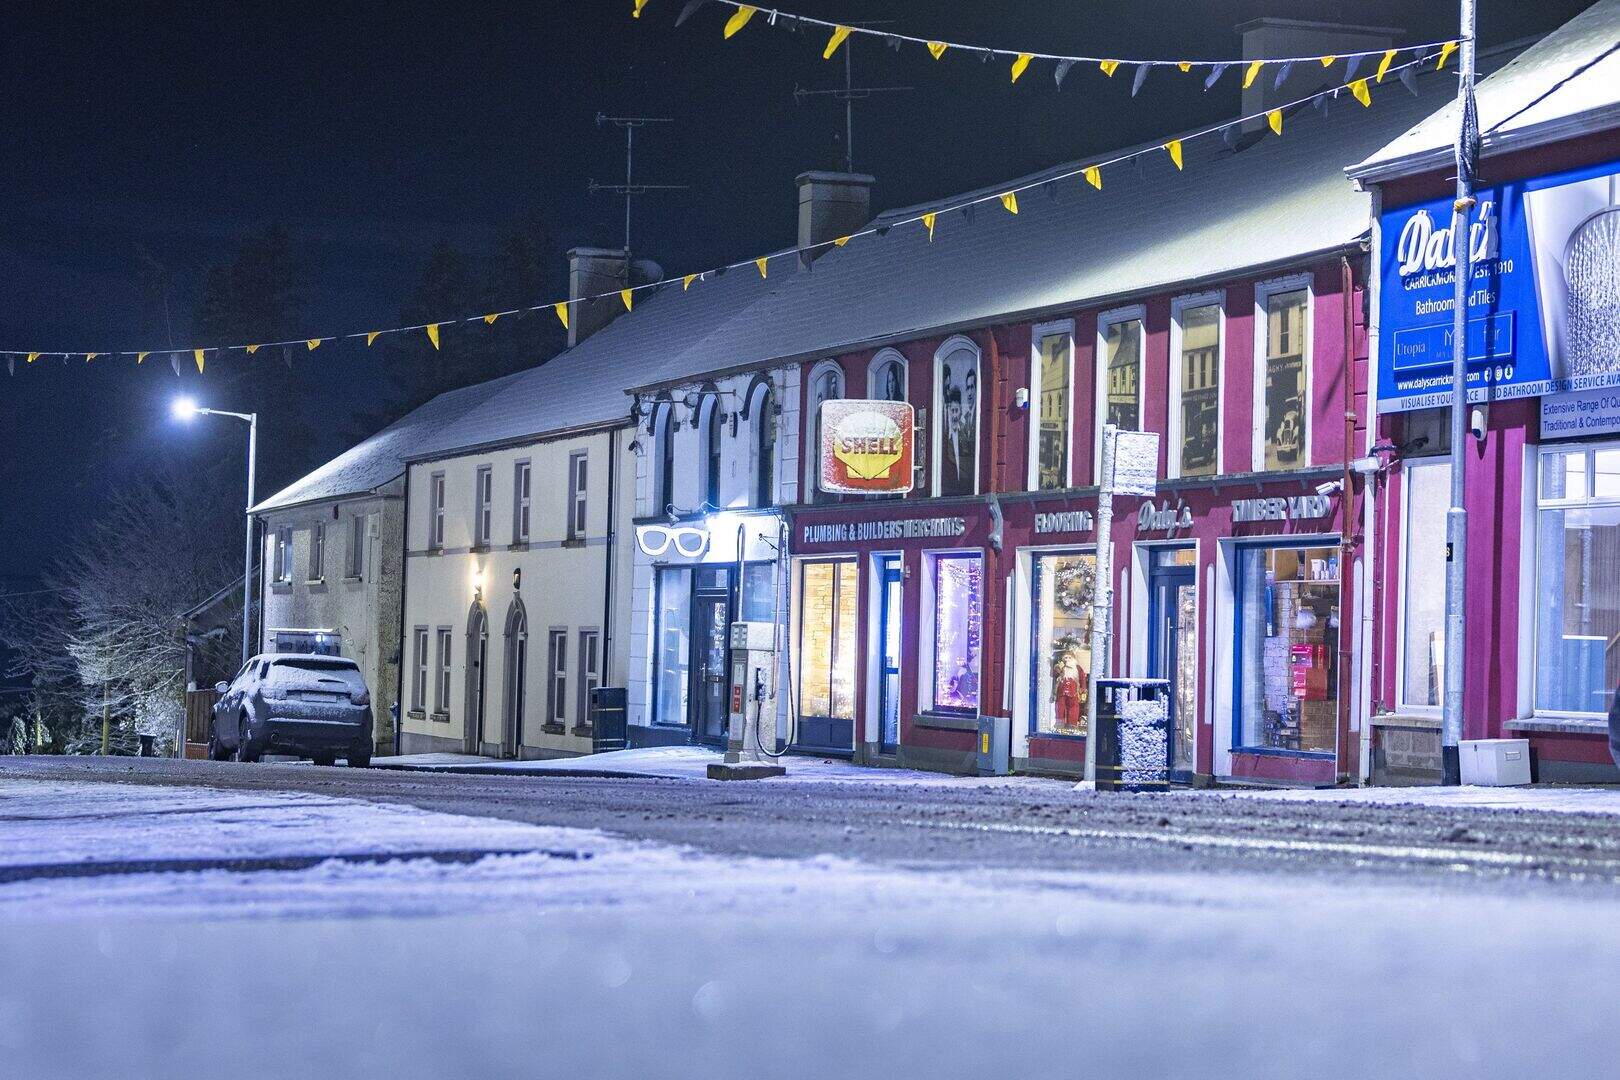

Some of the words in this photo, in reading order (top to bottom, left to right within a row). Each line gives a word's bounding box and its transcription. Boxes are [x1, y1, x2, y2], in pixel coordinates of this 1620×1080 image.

[1404, 270, 1456, 291] CARRICKMOR
[1494, 259, 1514, 275] 1910
[1477, 289, 1496, 305] Tiles
[1397, 343, 1426, 357] Utopia
[1401, 394, 1435, 409] VISUALISE
[1503, 382, 1543, 397] BATHROOM
[1545, 379, 1572, 393] DESIGN
[1573, 375, 1604, 390] SERVICE
[1544, 403, 1575, 415] Extensive
[1577, 400, 1599, 413] Range
[1600, 397, 1609, 409] Of
[1543, 417, 1577, 432] Traditional
[1578, 417, 1584, 429] &
[841, 436, 898, 456] SHELL
[1138, 498, 1195, 539] Daly's
[1231, 497, 1287, 522] TIMBER
[1287, 495, 1331, 519] YARD
[804, 524, 847, 543] PLUMBING
[849, 523, 856, 541] &
[857, 519, 903, 541] BUILDERS
[903, 517, 966, 538] MERCHANTS
[1034, 510, 1094, 533] FLOORING
